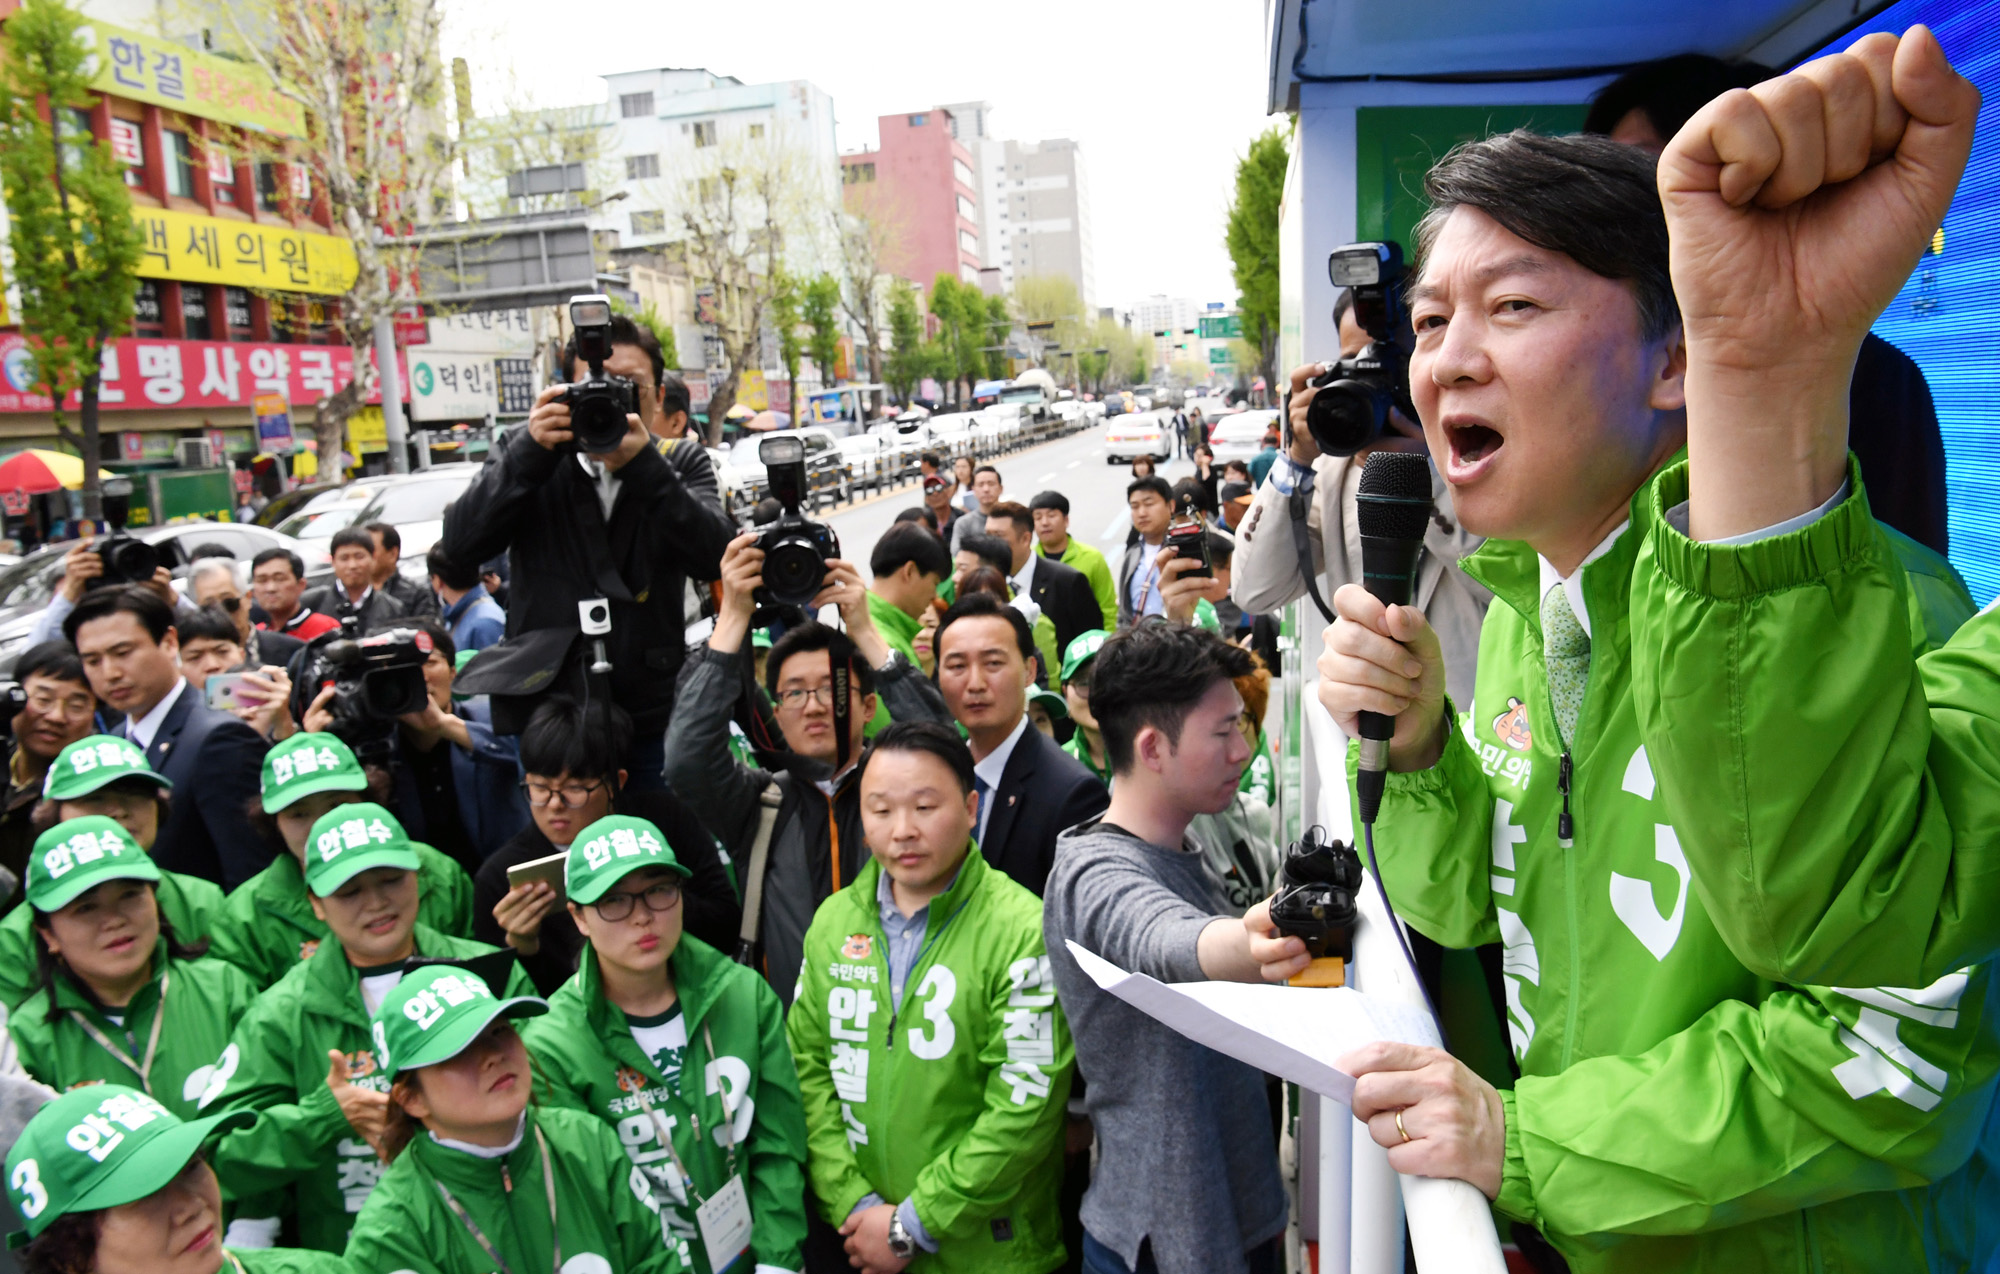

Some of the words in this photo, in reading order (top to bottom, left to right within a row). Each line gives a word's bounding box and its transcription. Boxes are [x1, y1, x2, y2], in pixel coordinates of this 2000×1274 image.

[108, 36, 187, 102] 한결
[142, 218, 310, 285] 백세의원
[1356, 360, 1382, 370] Nikon
[835, 667, 847, 718] Canon
[69, 742, 144, 776] 안철수
[271, 746, 341, 787] 안철수
[43, 829, 127, 881] 안철수
[317, 817, 394, 864] 안철수
[582, 827, 664, 872] 안철수
[402, 974, 491, 1031] 안철수
[907, 963, 957, 1060] 3
[1000, 953, 1056, 1106] 안철수
[65, 1091, 171, 1163] 안철수
[10, 1158, 49, 1220] 3
